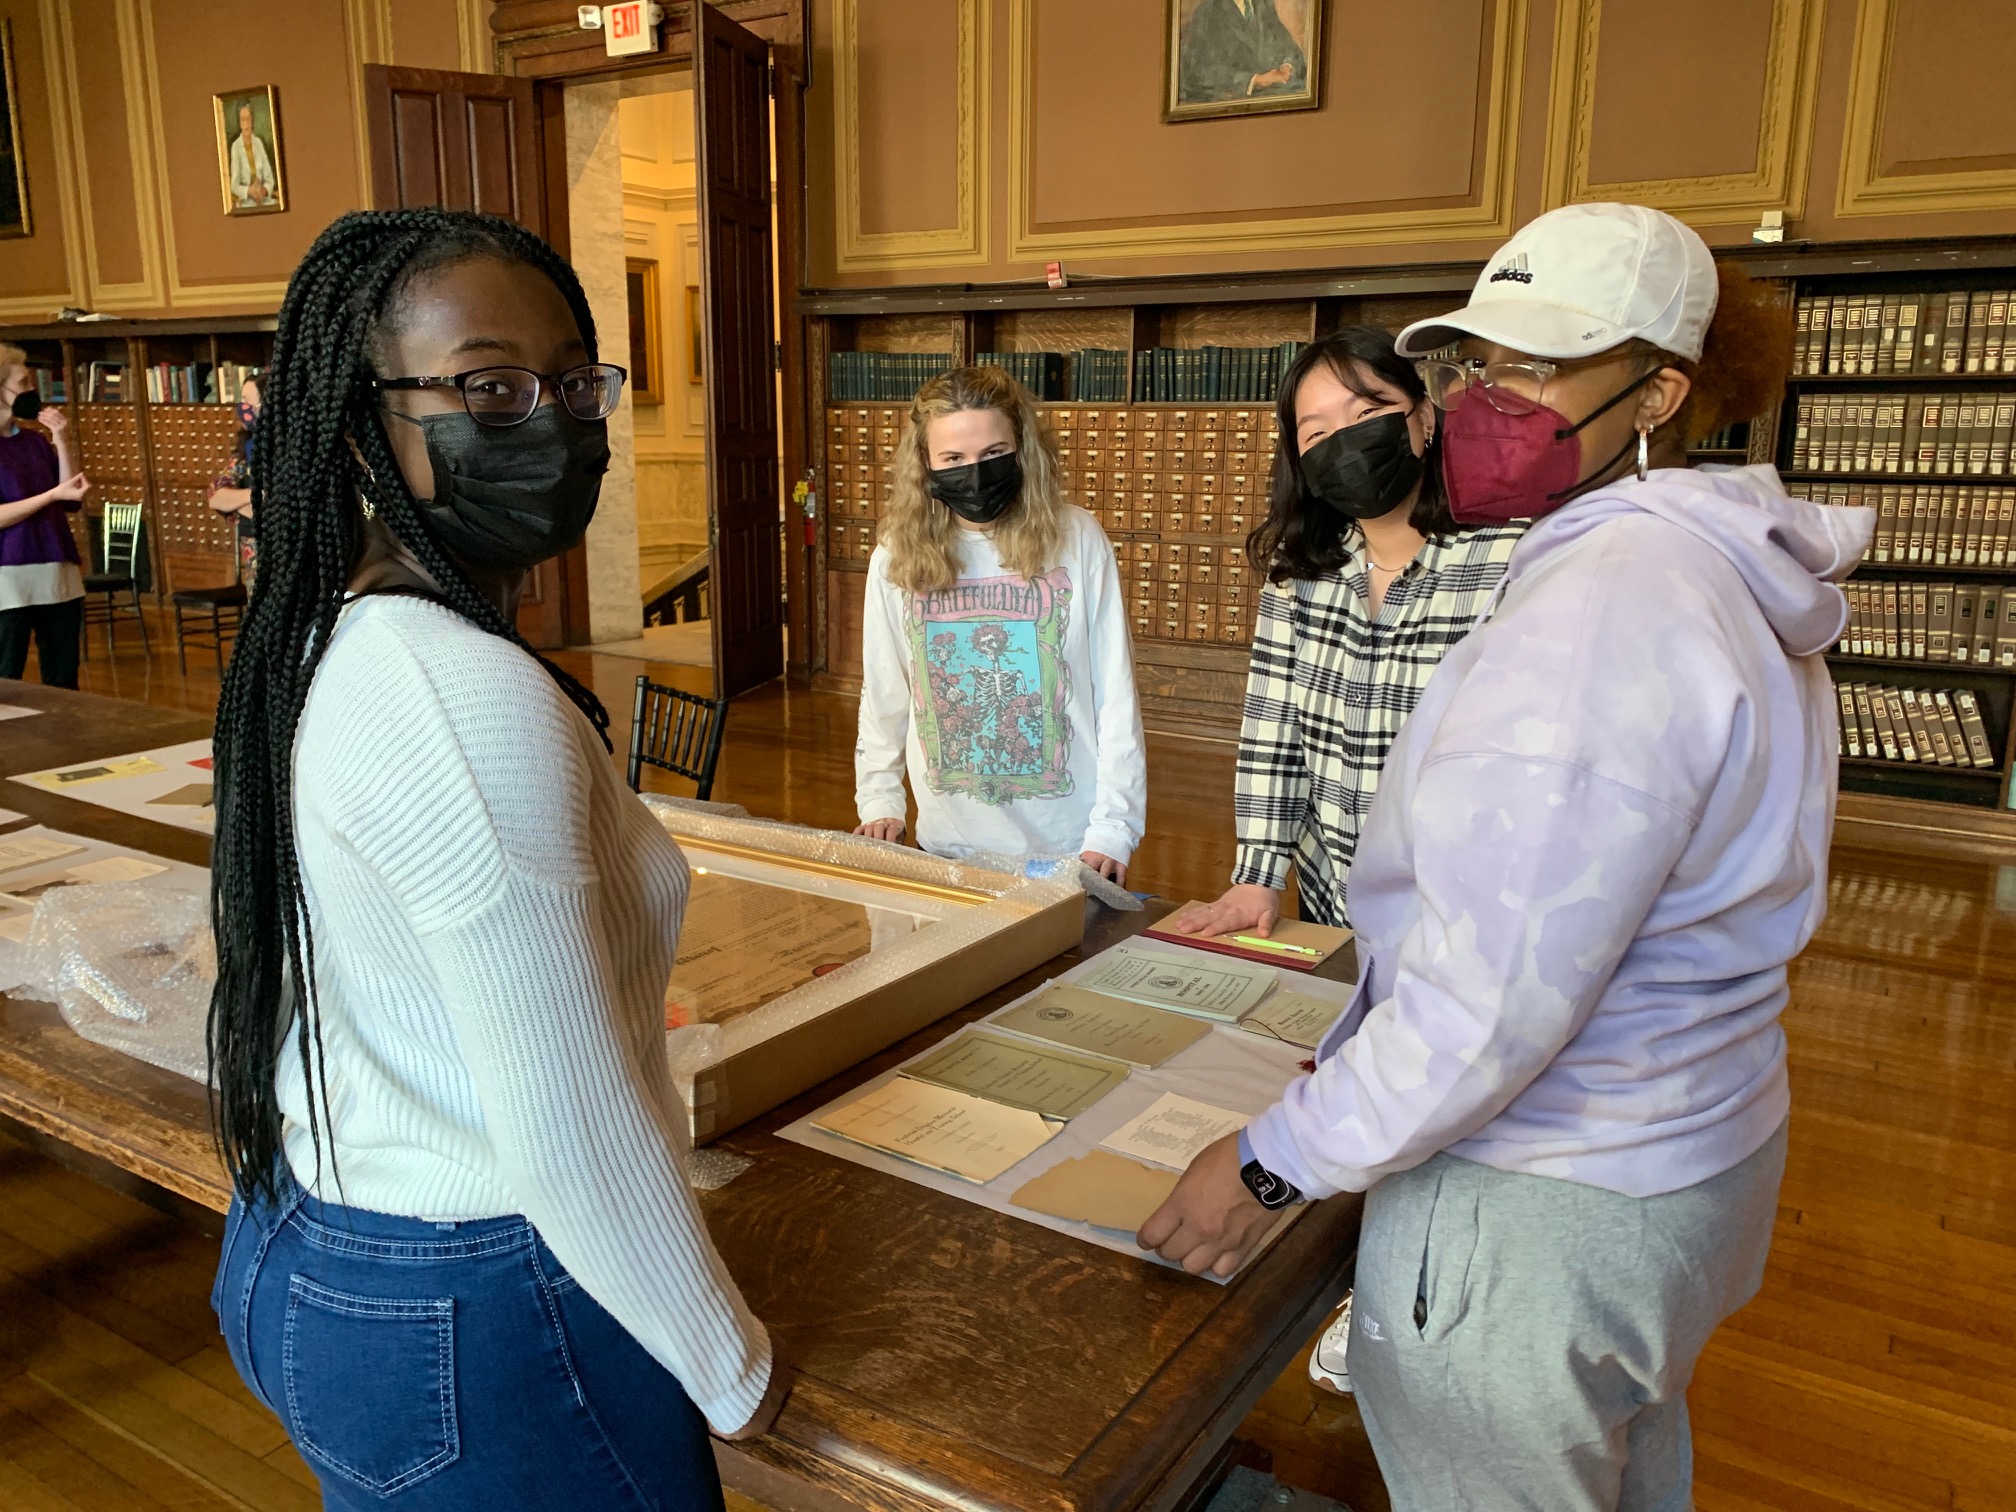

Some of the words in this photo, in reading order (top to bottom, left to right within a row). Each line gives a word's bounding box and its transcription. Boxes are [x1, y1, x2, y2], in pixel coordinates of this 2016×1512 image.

[611, 4, 640, 39] EXIT
[1490, 268, 1533, 284] adidas
[1176, 976, 1203, 998] HOSPITAL
